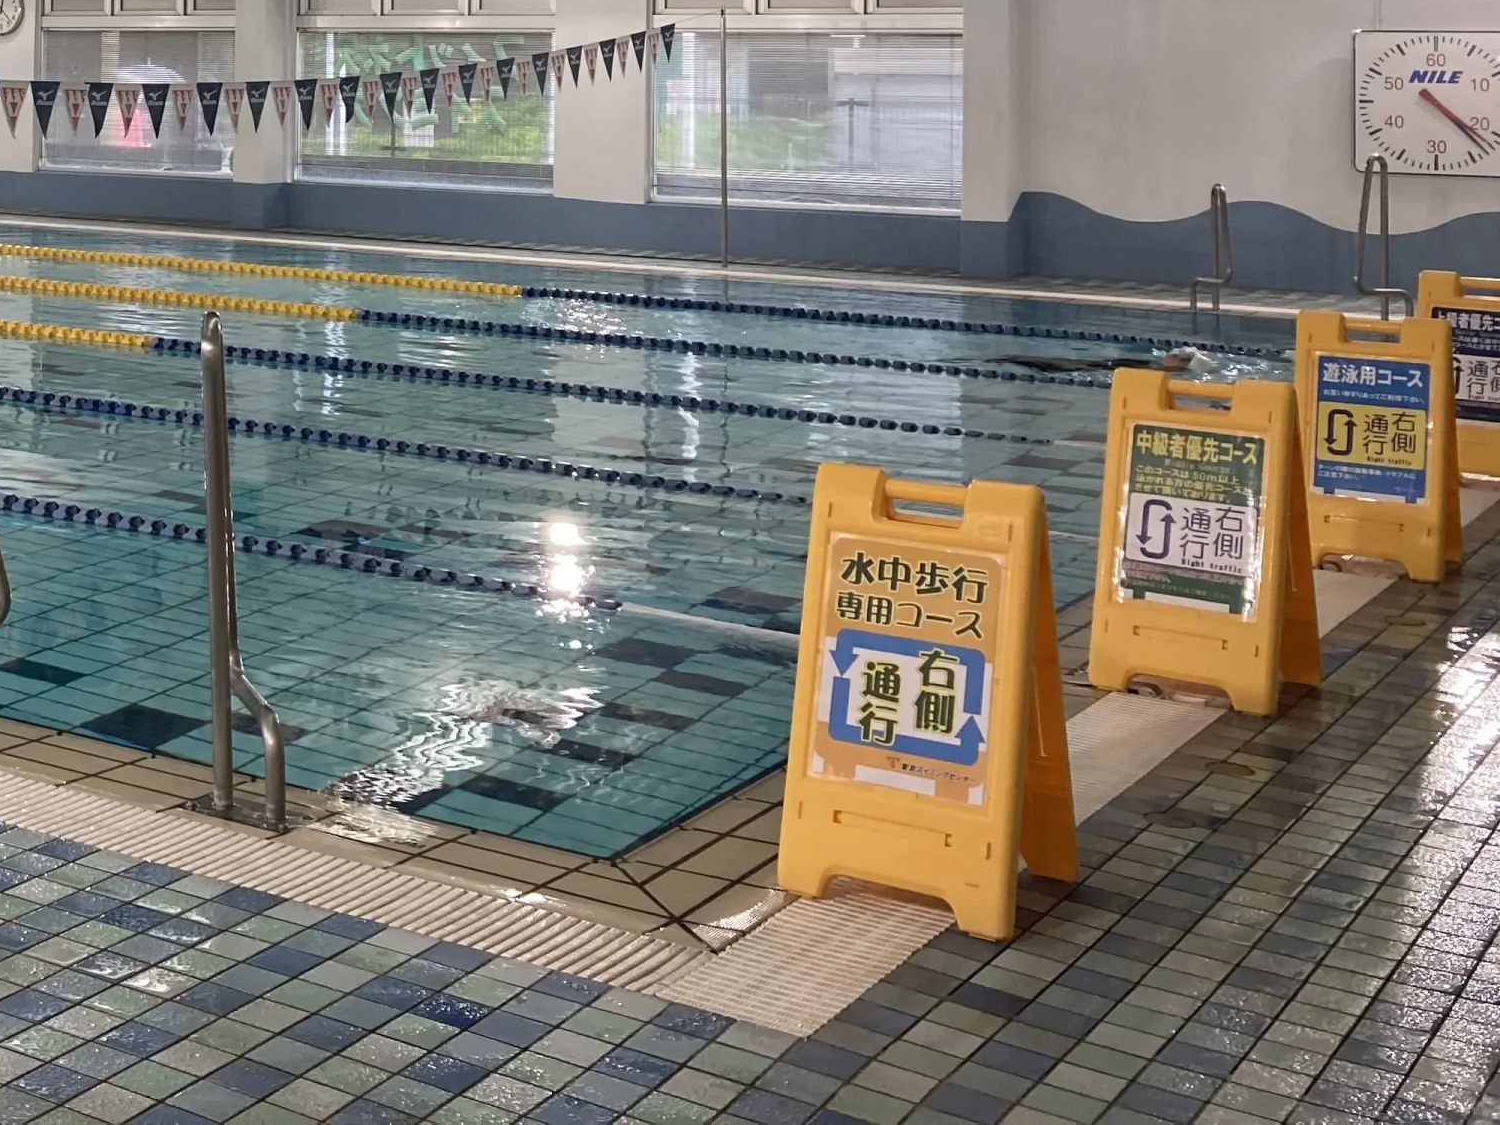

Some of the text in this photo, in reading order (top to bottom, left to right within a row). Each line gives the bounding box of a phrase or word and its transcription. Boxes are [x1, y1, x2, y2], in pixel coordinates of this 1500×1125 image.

[1408, 70, 1463, 84] NILE
[1426, 53, 1446, 67] 60
[1384, 77, 1404, 91] 50
[1471, 78, 1490, 92] 10
[1384, 115, 1404, 129] 40
[1470, 117, 1490, 131] 20
[1427, 140, 1447, 154] 30
[1323, 362, 1423, 388] 遊泳用コース
[1467, 360, 1489, 395] 通行
[1136, 430, 1258, 464] 中級者優先コース
[1362, 414, 1389, 455] 通行
[1391, 411, 1417, 454] 右側
[1180, 507, 1211, 560] 通行
[1213, 507, 1246, 560] 右側
[841, 551, 990, 605] 水中歩行
[1181, 559, 1204, 568] Right
[1210, 562, 1243, 574] traffic
[836, 591, 986, 641] 専用コース
[859, 660, 902, 746] 通行
[913, 648, 960, 735] 右側
